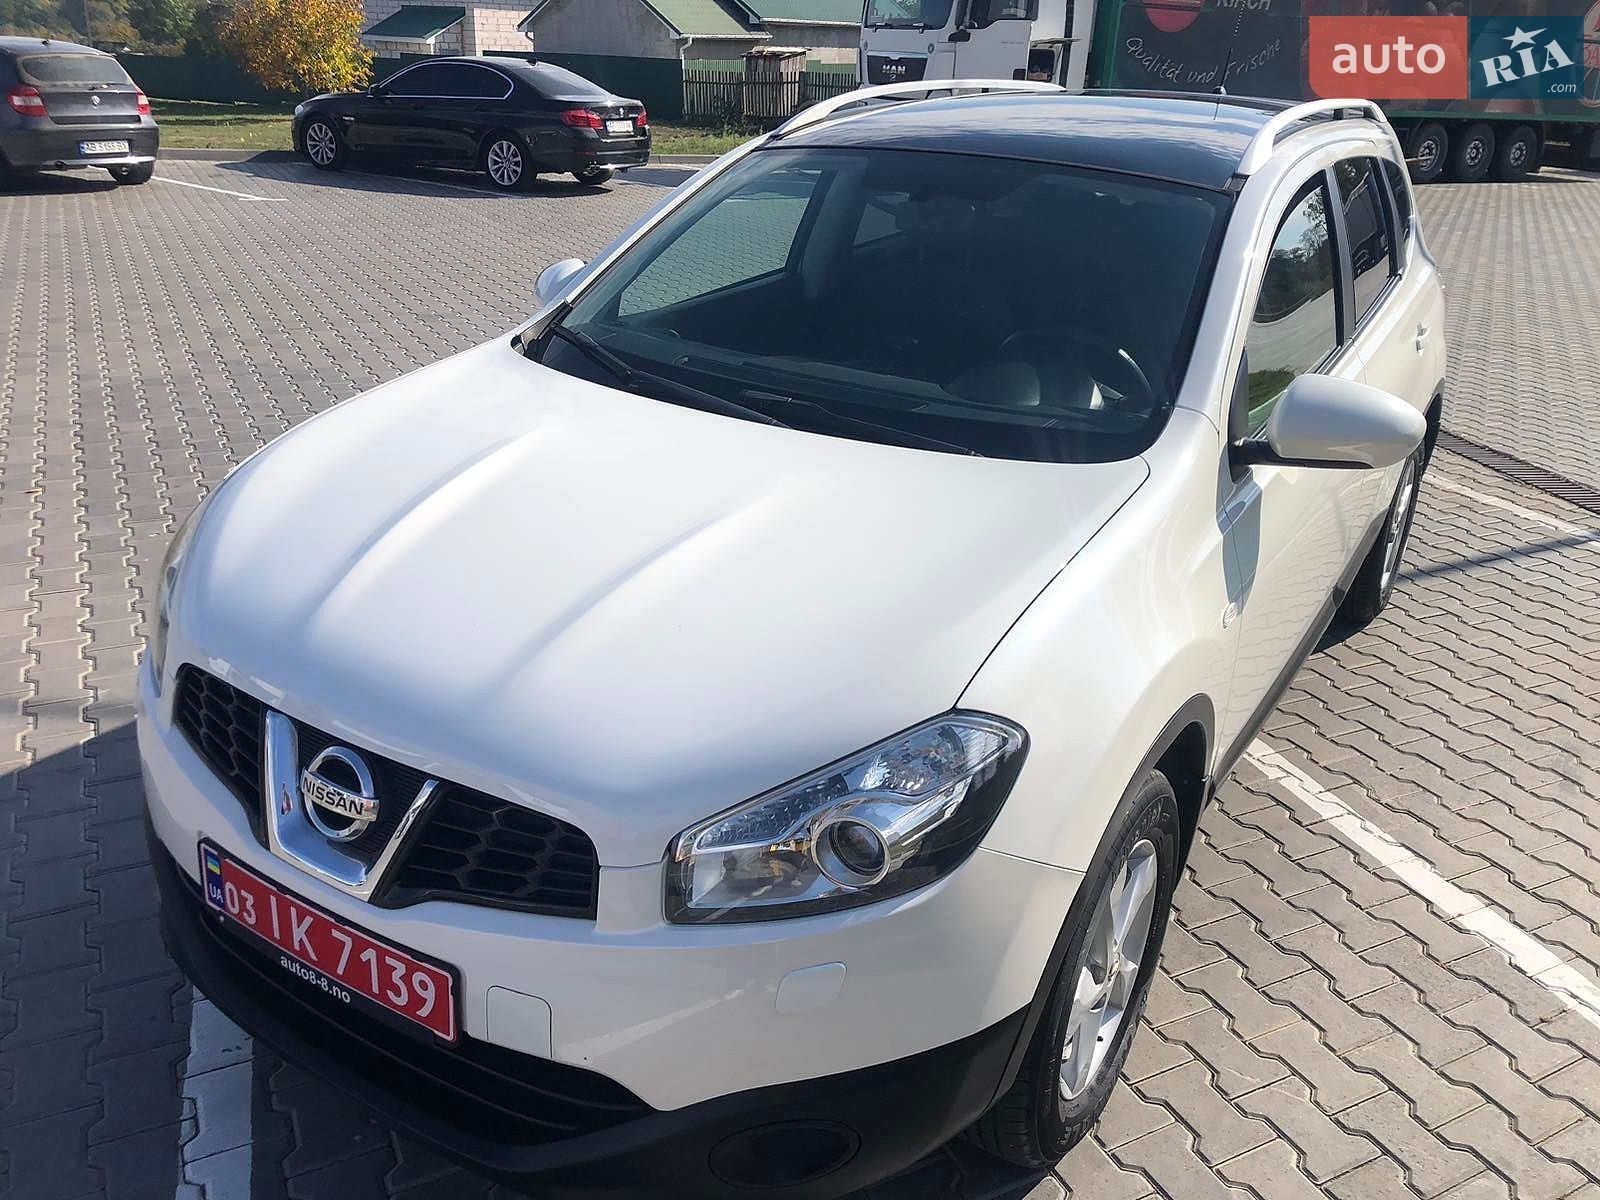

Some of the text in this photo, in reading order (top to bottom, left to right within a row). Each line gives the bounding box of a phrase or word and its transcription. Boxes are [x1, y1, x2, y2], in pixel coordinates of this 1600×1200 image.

[882, 64, 906, 75] MAN
[1187, 66, 1219, 84] und
[303, 777, 364, 815] NISSAN
[209, 883, 224, 903] UA
[225, 881, 436, 1018] 03 IK 7139
[280, 956, 351, 1004] auto8-8.no
